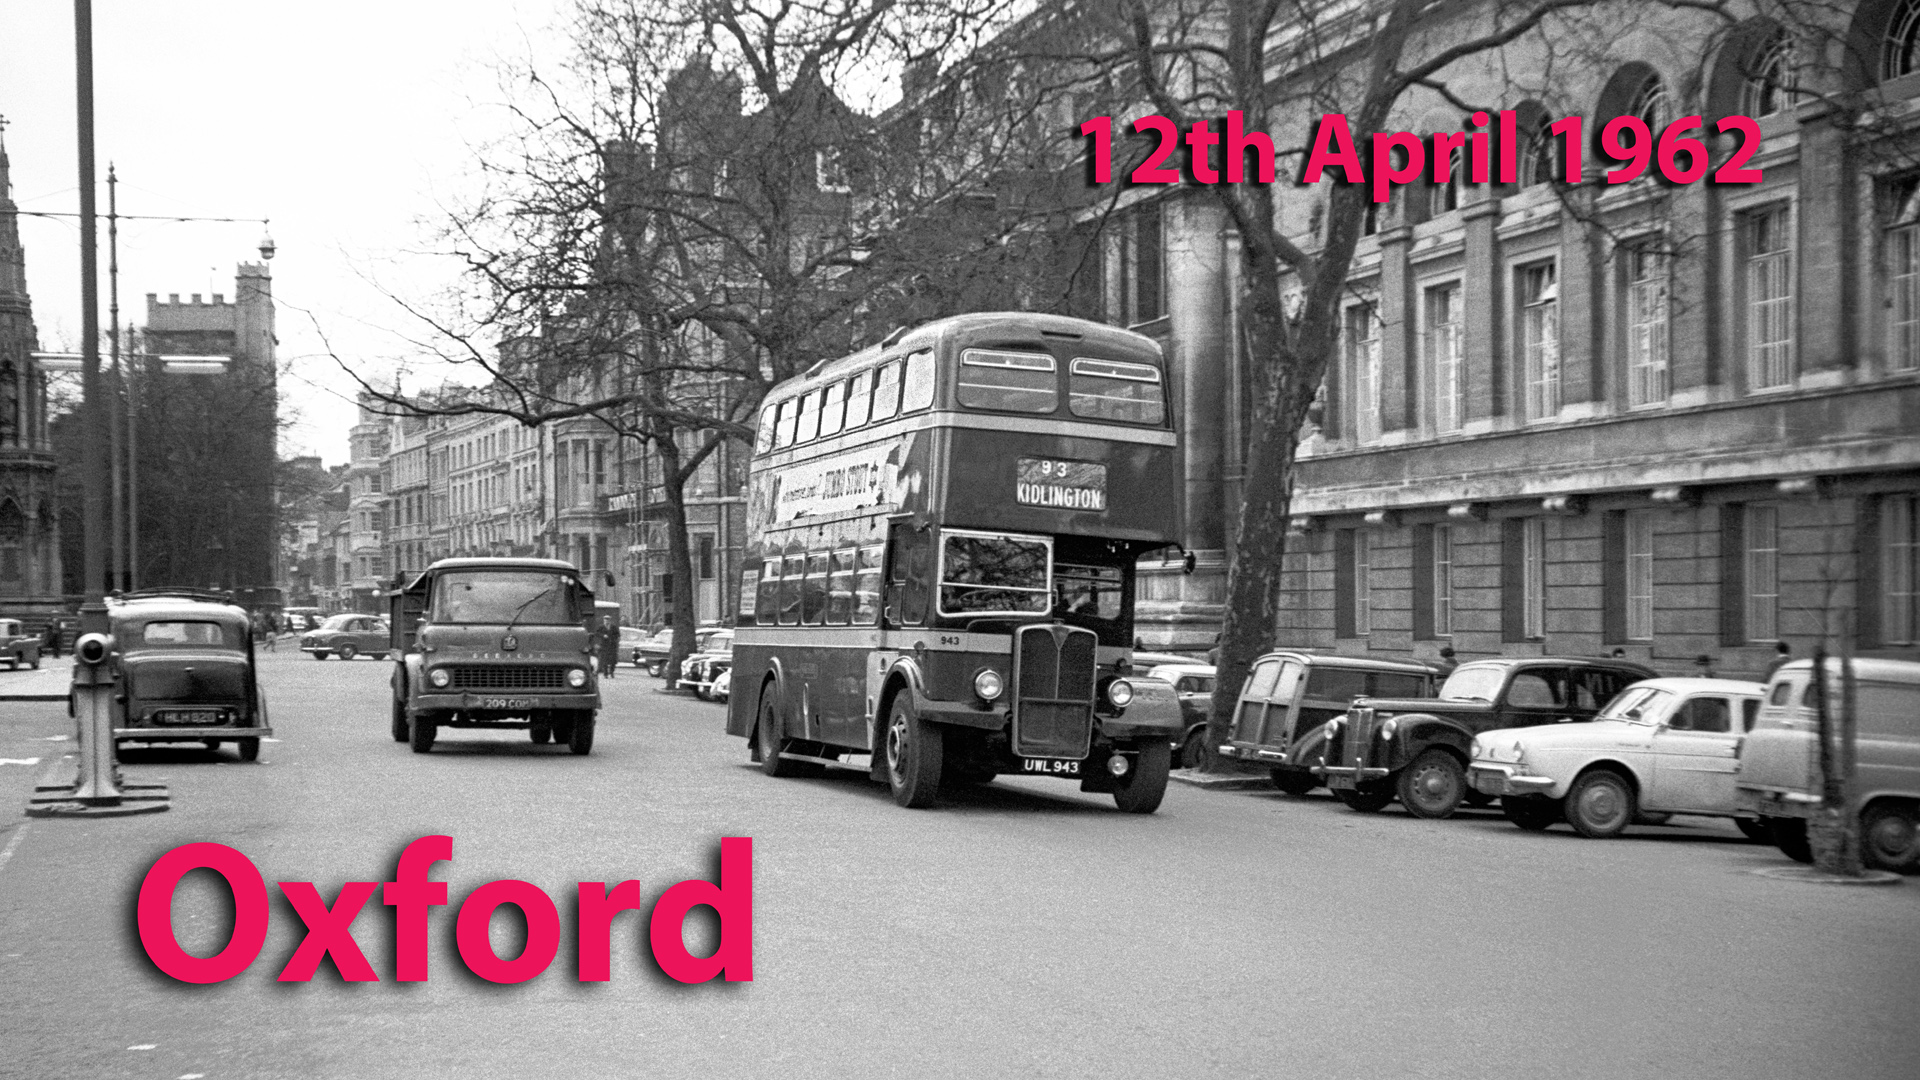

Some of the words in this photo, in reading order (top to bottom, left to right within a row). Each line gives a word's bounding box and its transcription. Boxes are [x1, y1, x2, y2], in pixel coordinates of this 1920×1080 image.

[1017, 483, 1101, 508] KIDLINGTON
[941, 636, 960, 645] 943
[486, 699, 506, 708] 209
[1025, 760, 1051, 772] UWL
[1053, 761, 1079, 773] 943
